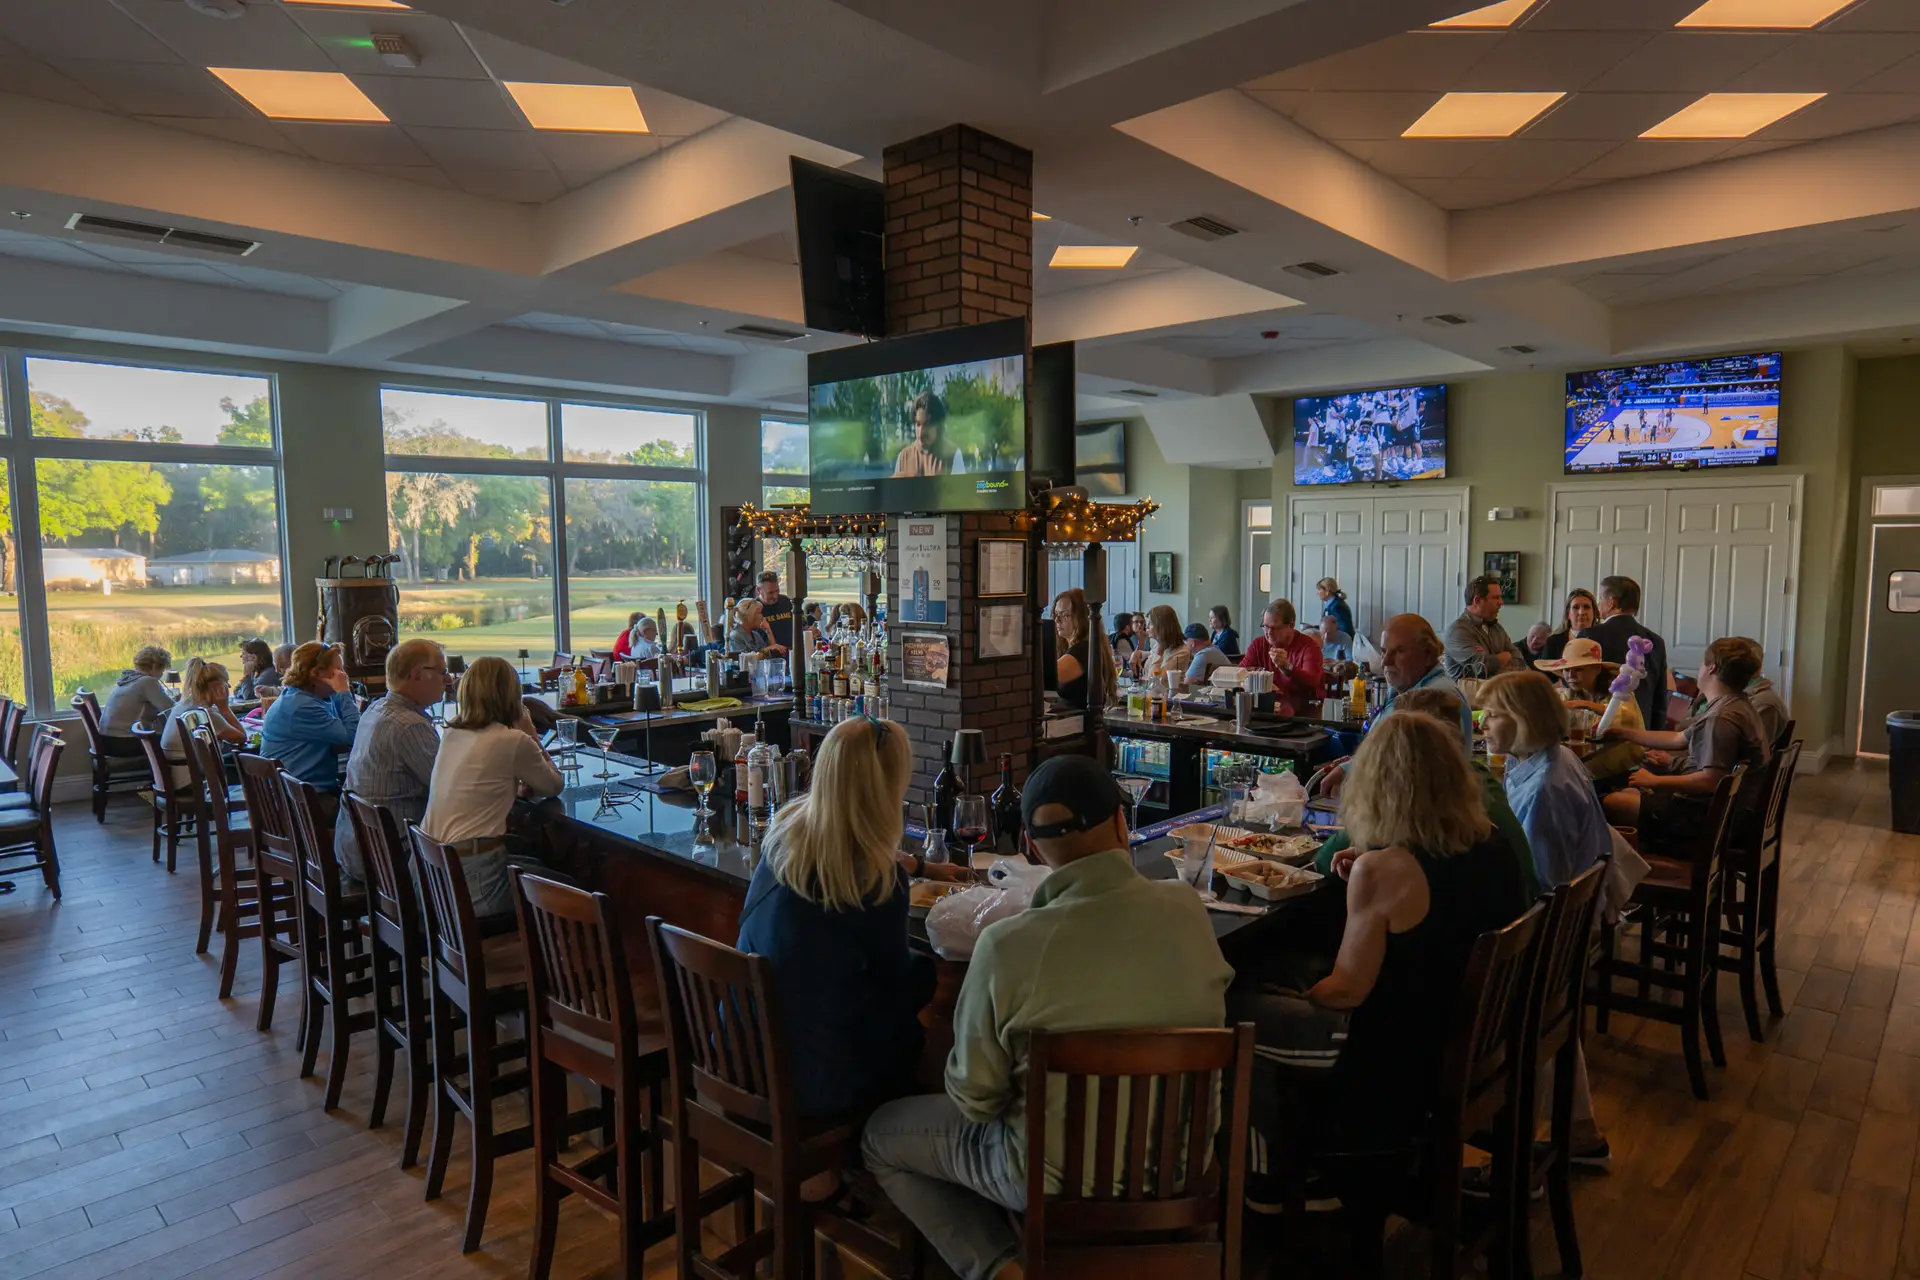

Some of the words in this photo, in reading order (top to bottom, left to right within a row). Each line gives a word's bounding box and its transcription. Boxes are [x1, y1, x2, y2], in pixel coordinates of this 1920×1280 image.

[1565, 421, 1609, 453] TIGERS
[912, 526, 932, 534] NEW
[933, 579, 941, 587] 29
